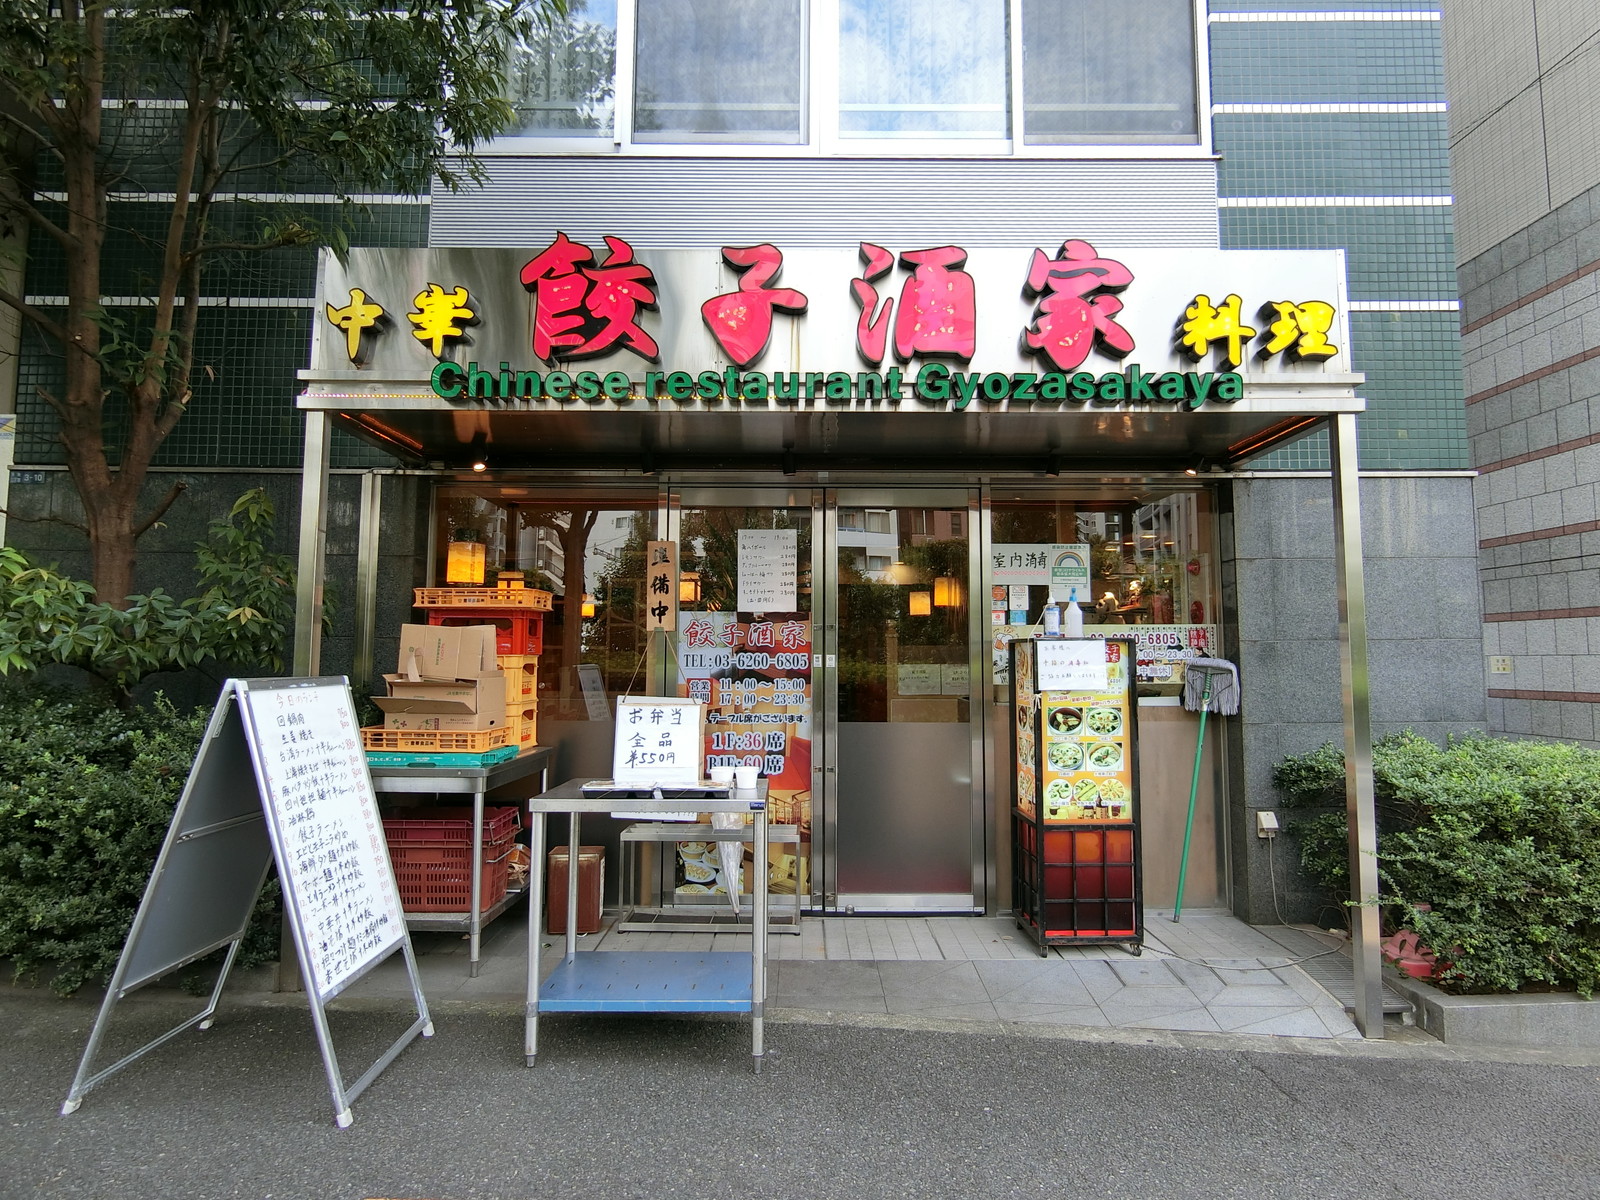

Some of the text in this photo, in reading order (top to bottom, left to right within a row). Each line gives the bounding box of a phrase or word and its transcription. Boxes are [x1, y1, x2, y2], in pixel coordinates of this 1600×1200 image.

[520, 231, 1135, 371] 餃子酒家
[327, 283, 475, 360] 中華
[1181, 294, 1339, 369] 料理
[431, 361, 1244, 411] Chinese restaurant Gyozasakaya
[992, 551, 1048, 569] 室内消毒
[684, 620, 807, 650] 餃子酒家
[689, 679, 710, 691] 営業
[628, 707, 682, 725] お弁当
[627, 731, 673, 748] 全品
